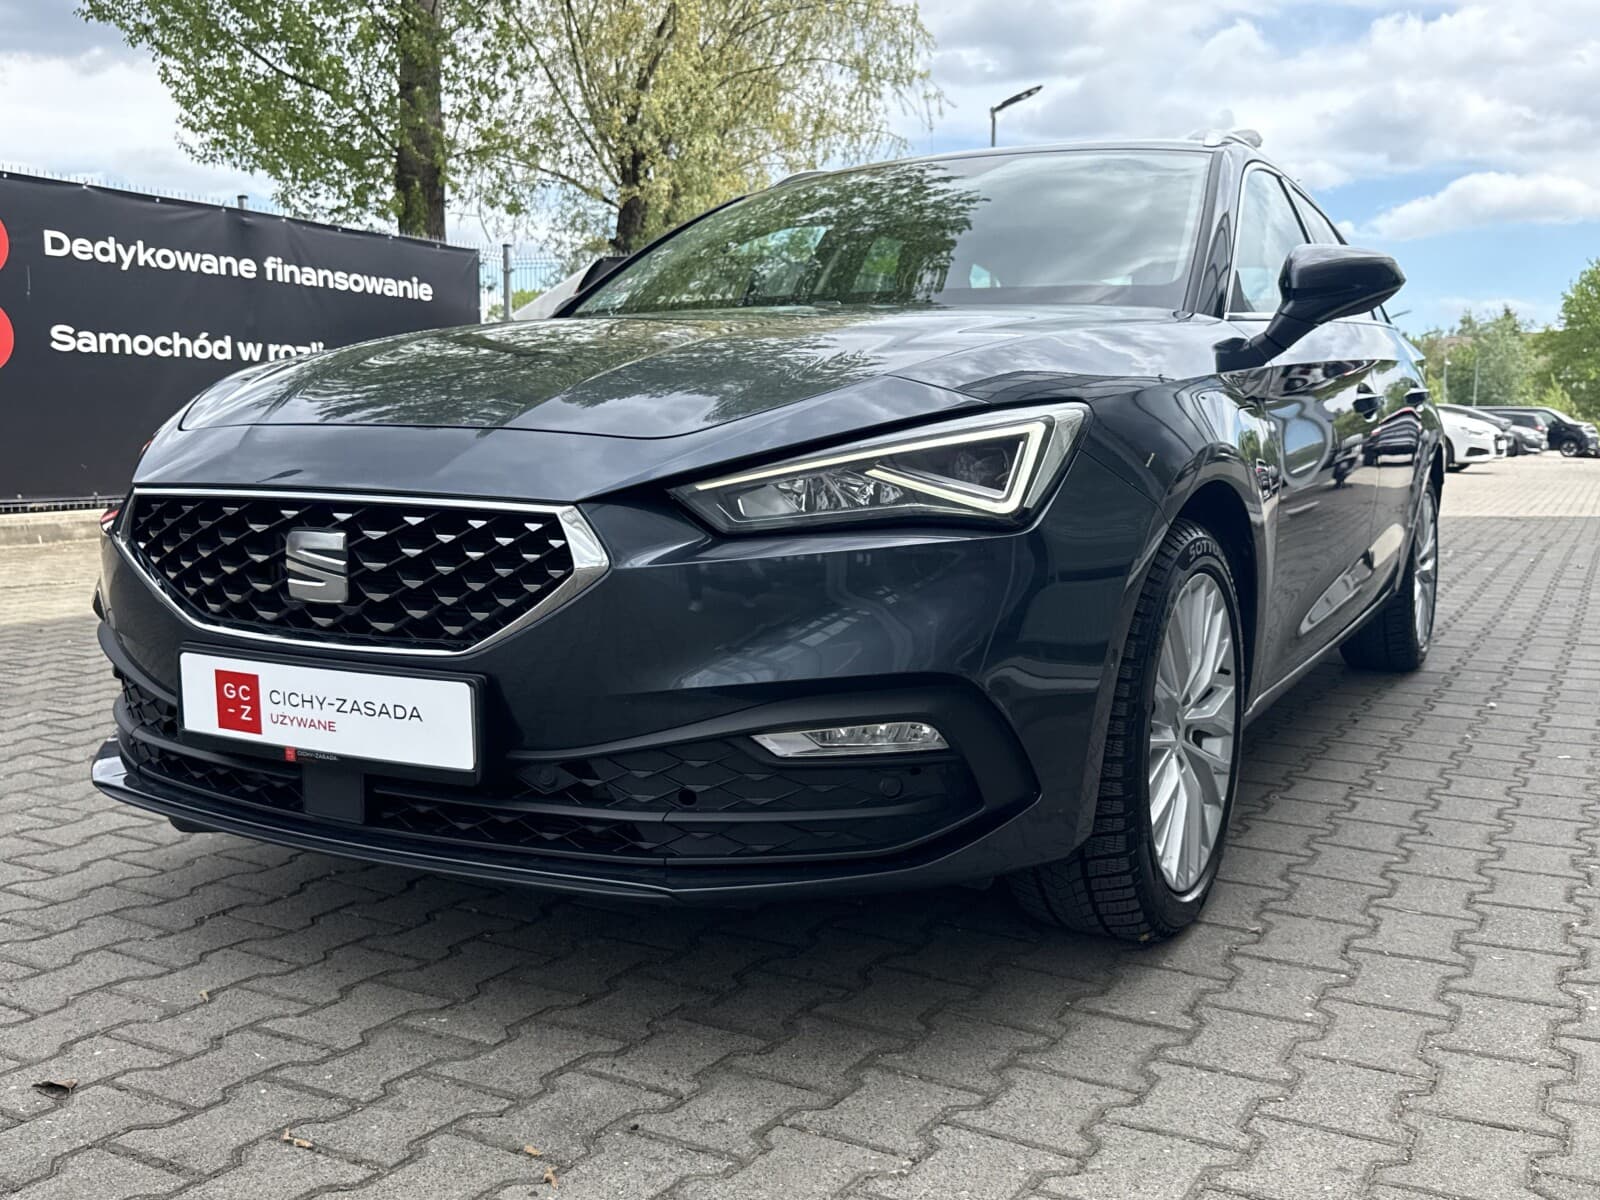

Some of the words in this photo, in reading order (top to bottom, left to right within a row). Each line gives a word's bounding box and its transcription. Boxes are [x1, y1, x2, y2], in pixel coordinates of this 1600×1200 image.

[43, 229, 257, 279] Dedykowane
[263, 256, 434, 302] finansowanie
[50, 324, 232, 361] Samochód
[237, 342, 262, 362] w
[223, 683, 251, 701] GC
[269, 690, 423, 722] CICHY-ZASADA
[270, 713, 337, 732] UŻYWANE
